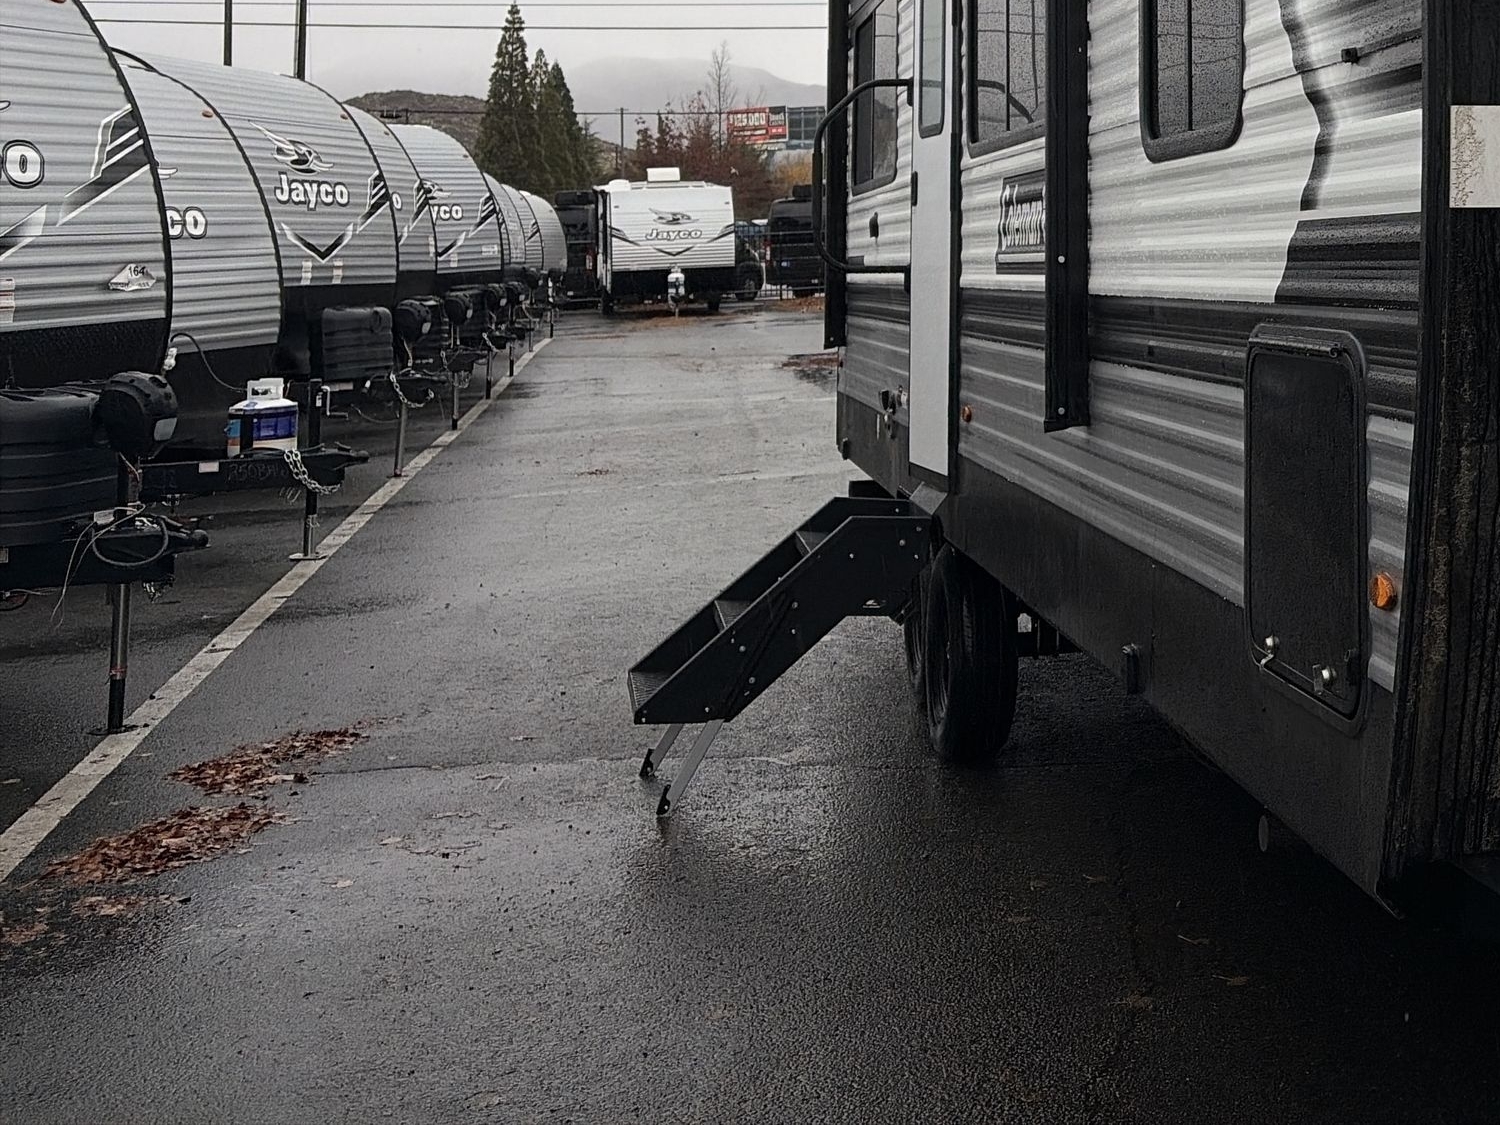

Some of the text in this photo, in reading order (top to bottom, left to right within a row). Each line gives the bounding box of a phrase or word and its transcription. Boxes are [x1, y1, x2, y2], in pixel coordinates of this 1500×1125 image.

[274, 171, 350, 211] Jayco
[1000, 184, 1042, 251] Coleman
[645, 228, 703, 242] Jayco
[128, 266, 146, 277] 164
